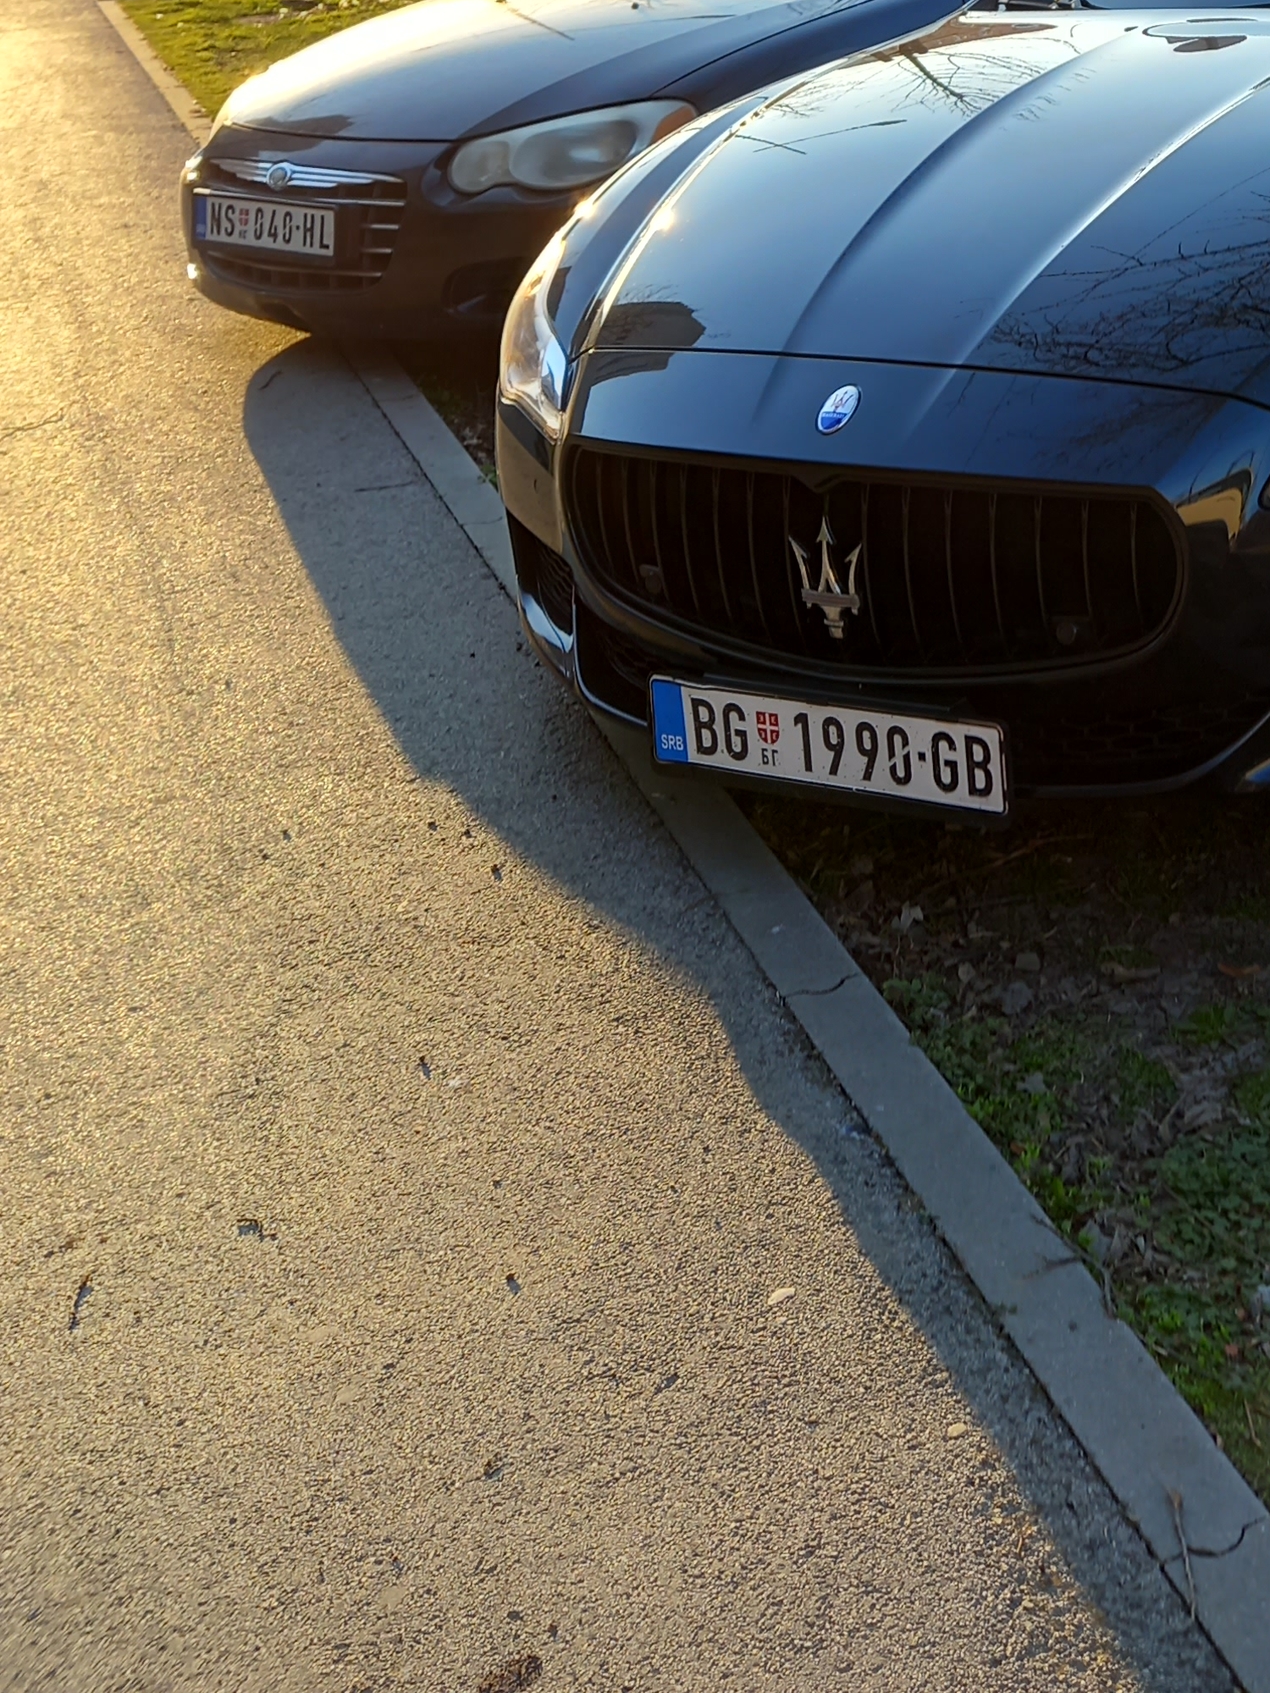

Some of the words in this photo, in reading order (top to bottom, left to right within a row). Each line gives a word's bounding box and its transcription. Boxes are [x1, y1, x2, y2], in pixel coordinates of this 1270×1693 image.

[210, 202, 235, 237] NS
[661, 734, 684, 751] SRB
[690, 697, 749, 761] BG
